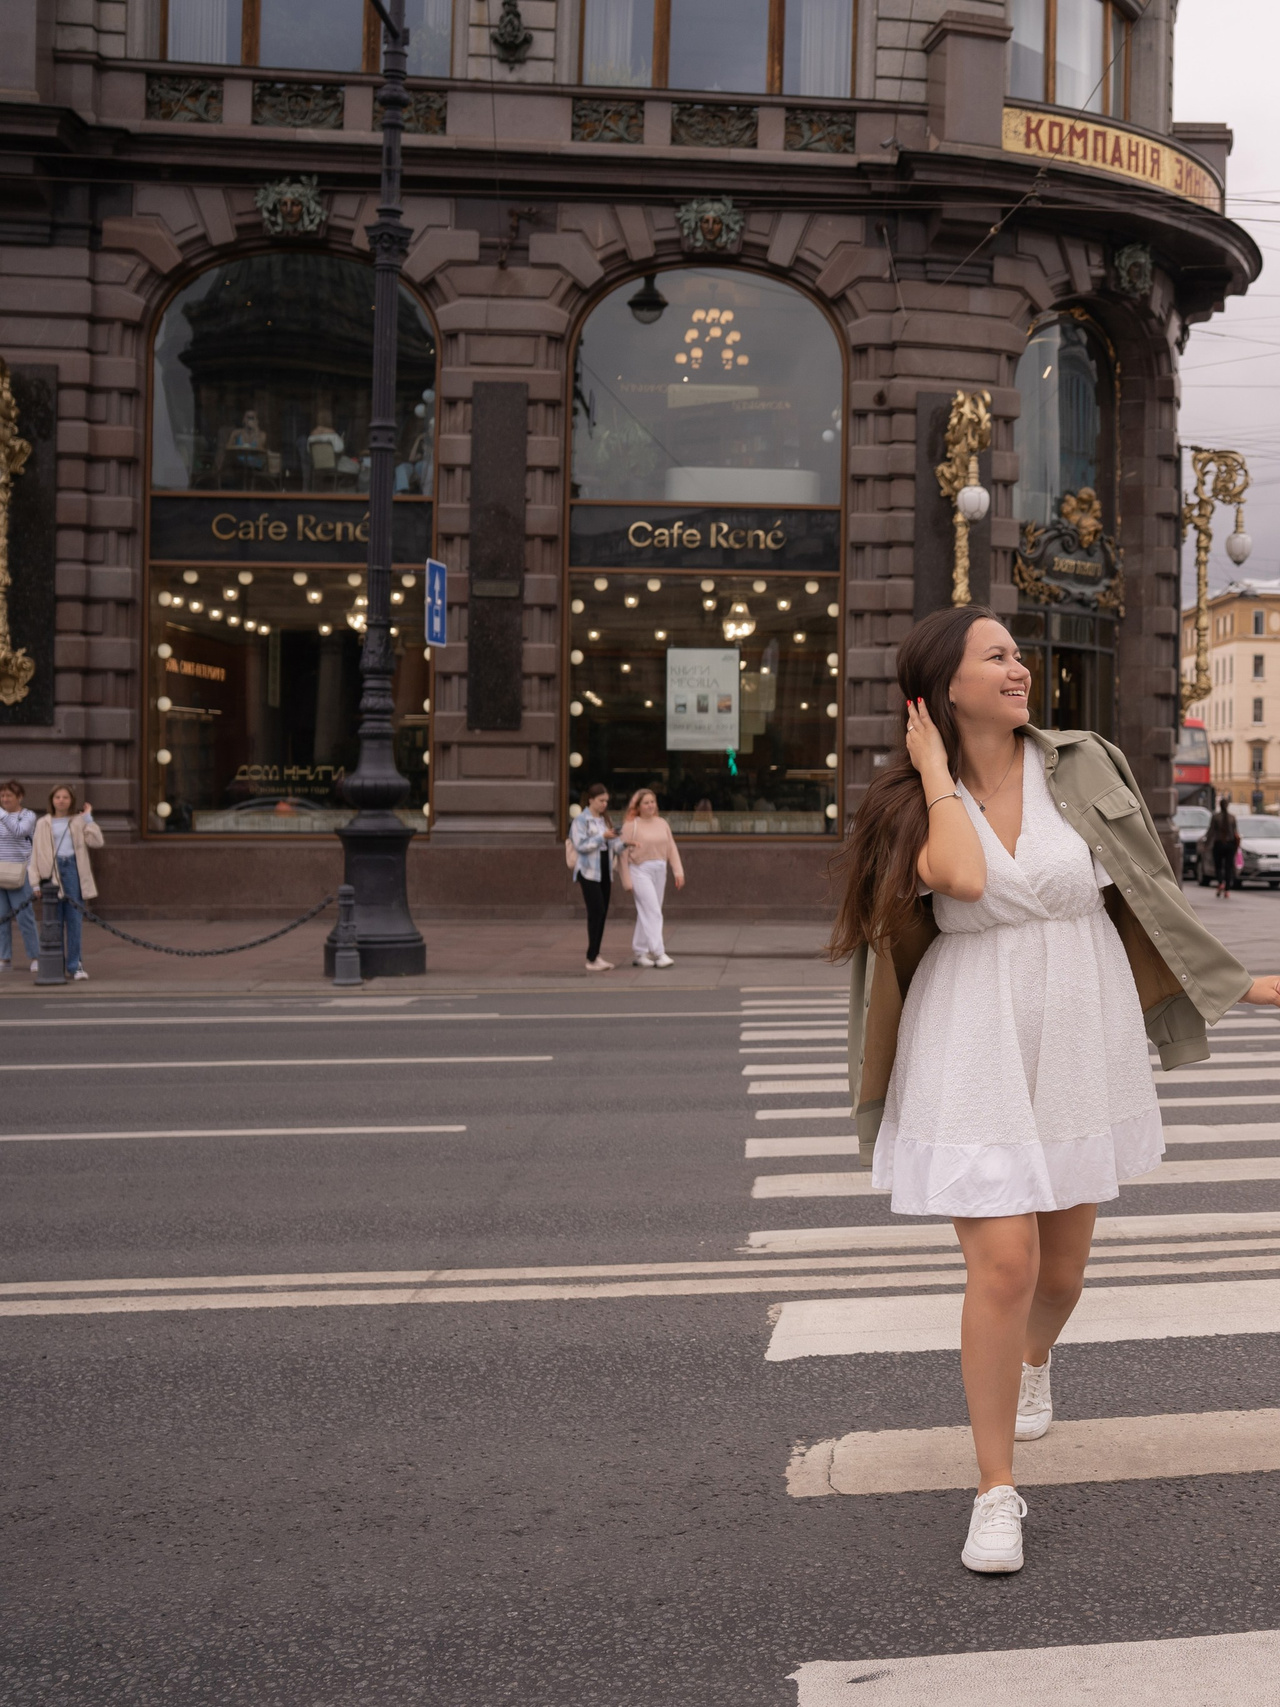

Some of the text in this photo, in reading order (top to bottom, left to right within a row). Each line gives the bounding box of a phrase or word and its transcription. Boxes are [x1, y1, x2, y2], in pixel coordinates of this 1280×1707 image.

[1024, 115, 1161, 181] КОМПАНІЯ
[211, 512, 289, 541] Cafe
[628, 519, 788, 550] Cafe René
[235, 764, 280, 781] ДОМ
